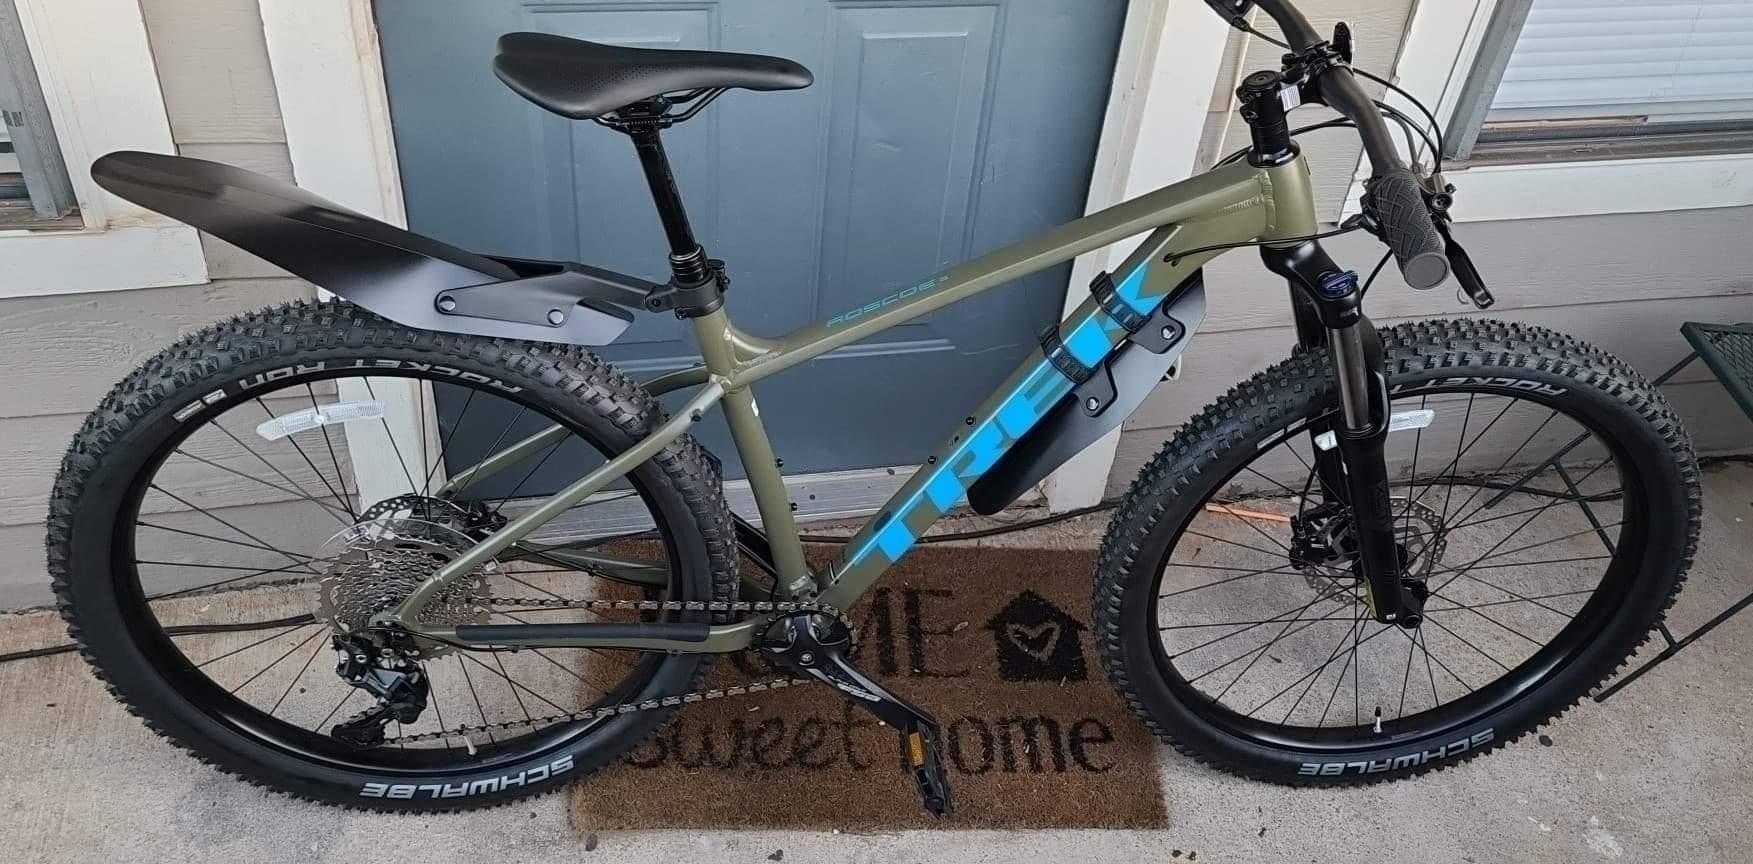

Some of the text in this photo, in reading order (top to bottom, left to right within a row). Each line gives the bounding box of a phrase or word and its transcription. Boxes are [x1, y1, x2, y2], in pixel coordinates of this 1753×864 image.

[826, 279, 936, 328] ROSCOE
[352, 359, 523, 394] ROCKET
[1423, 376, 1568, 396] ROCKET
[846, 262, 1166, 564] TREK
[1297, 727, 1495, 777] SCHWALBE
[359, 754, 575, 800] SCHWALBE
